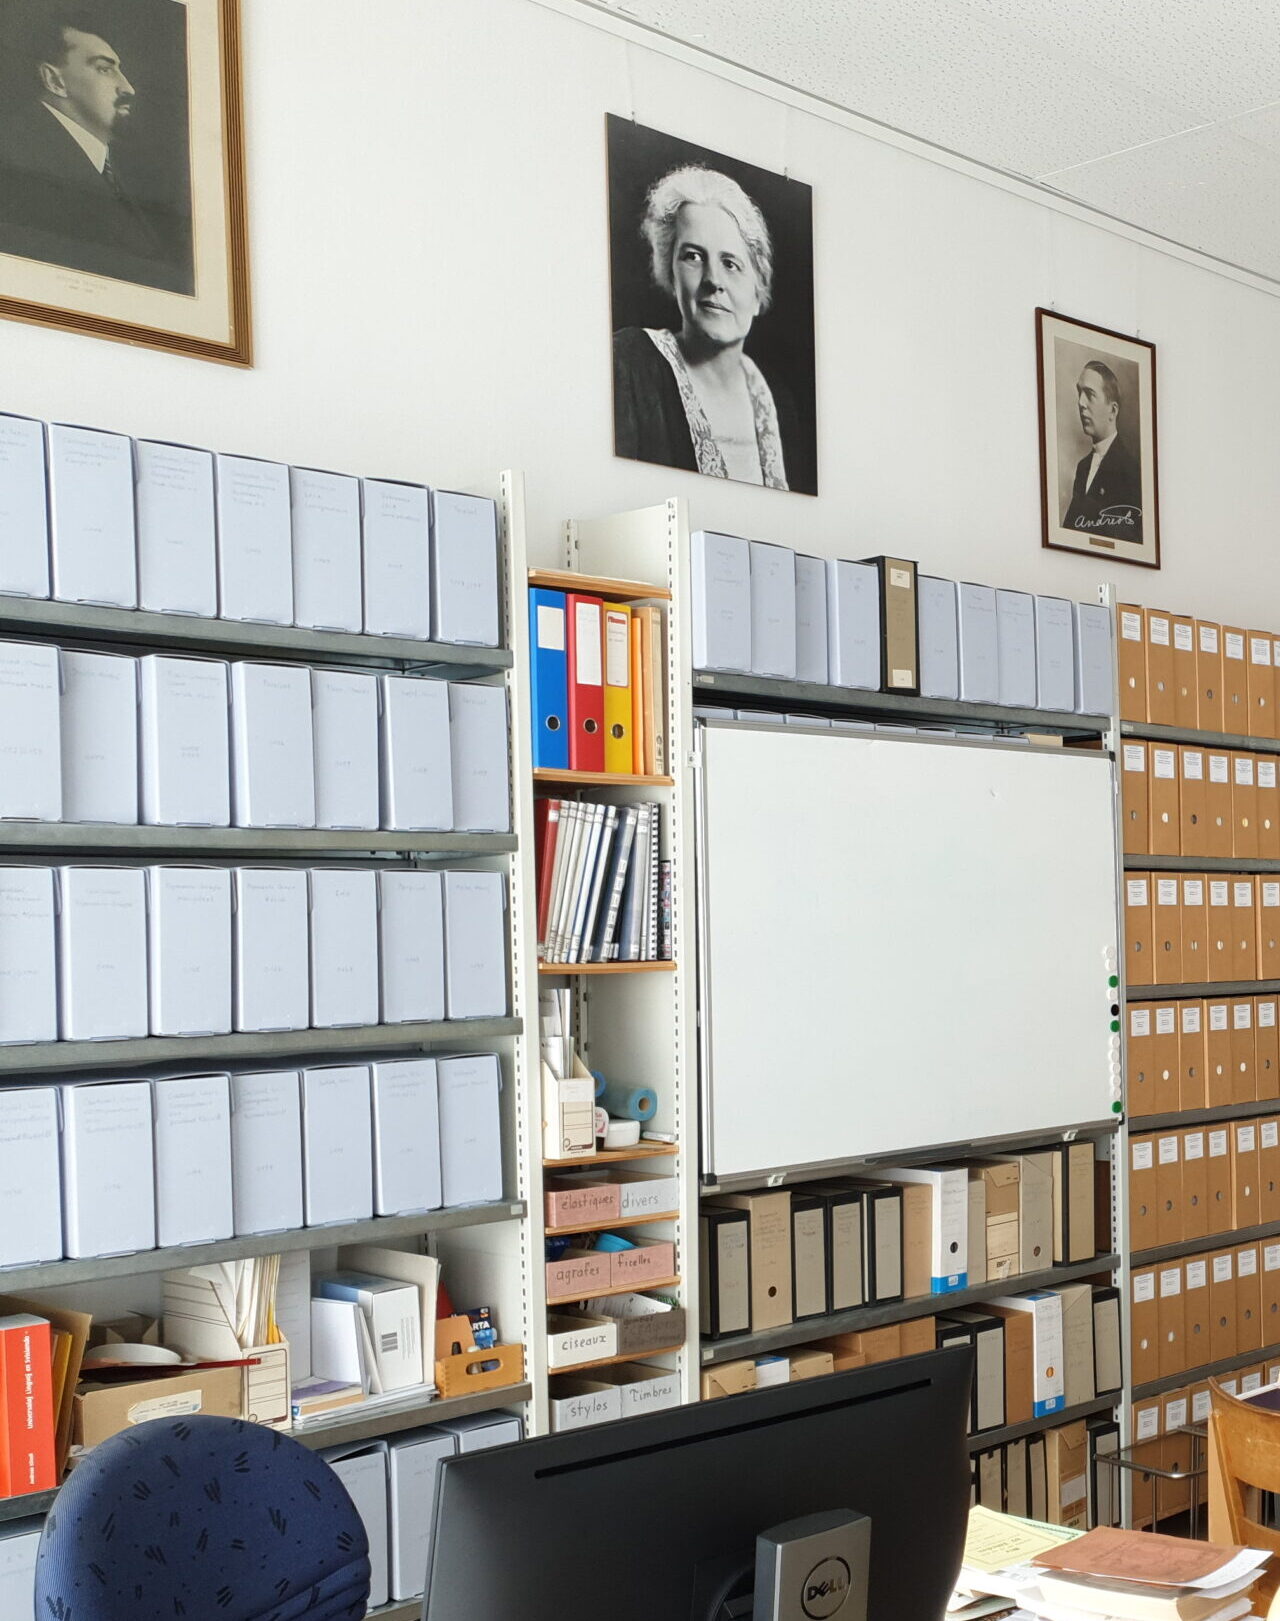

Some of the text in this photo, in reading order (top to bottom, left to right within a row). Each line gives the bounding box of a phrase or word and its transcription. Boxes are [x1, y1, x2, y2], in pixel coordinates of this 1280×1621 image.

[561, 1193, 615, 1210] élastiques
[622, 1192, 659, 1209] divers
[617, 1253, 651, 1268] ficelles
[556, 1262, 600, 1284] agrafes
[561, 1335, 608, 1351] ciseaux
[629, 1387, 673, 1403] Timbres
[570, 1399, 608, 1418] stylos
[807, 1579, 845, 1601] DELL
